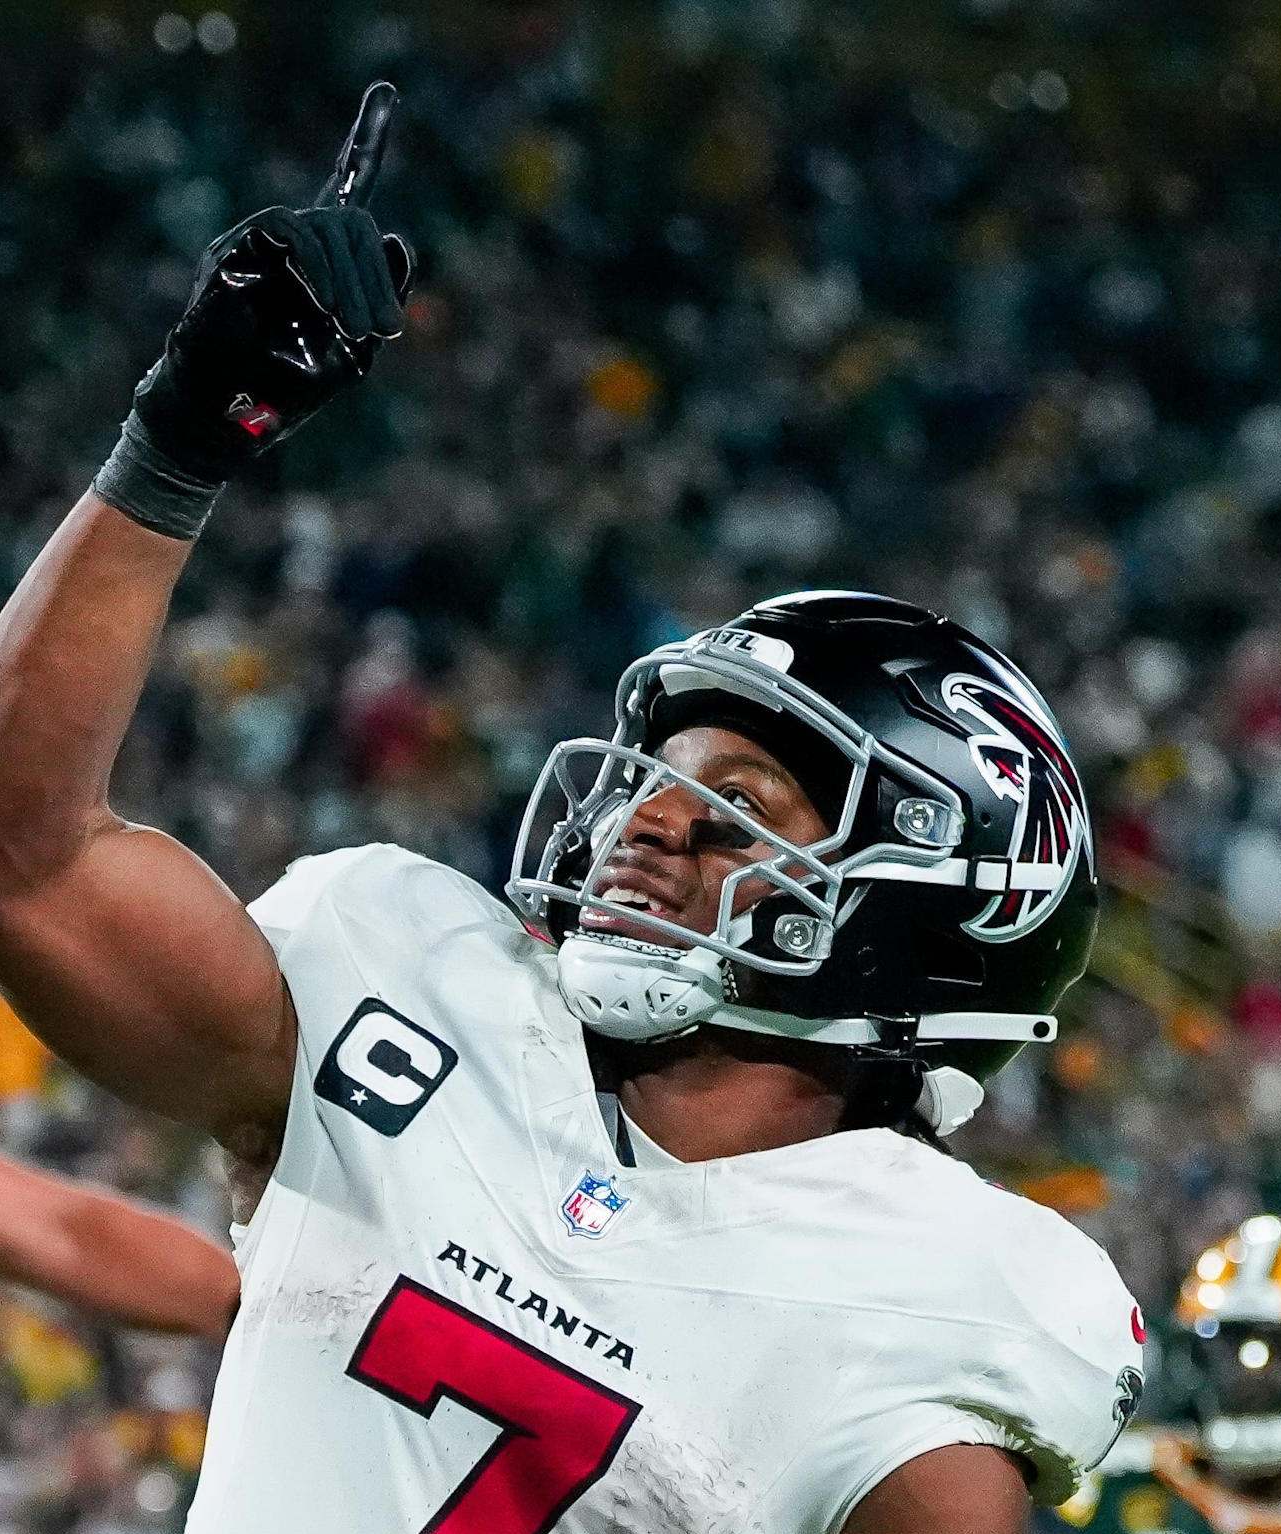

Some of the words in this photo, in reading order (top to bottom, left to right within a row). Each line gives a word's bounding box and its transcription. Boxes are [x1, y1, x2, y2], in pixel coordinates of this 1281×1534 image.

[700, 629, 755, 652] ATL
[334, 1010, 445, 1107] C
[437, 1240, 638, 1371] ATLANTA
